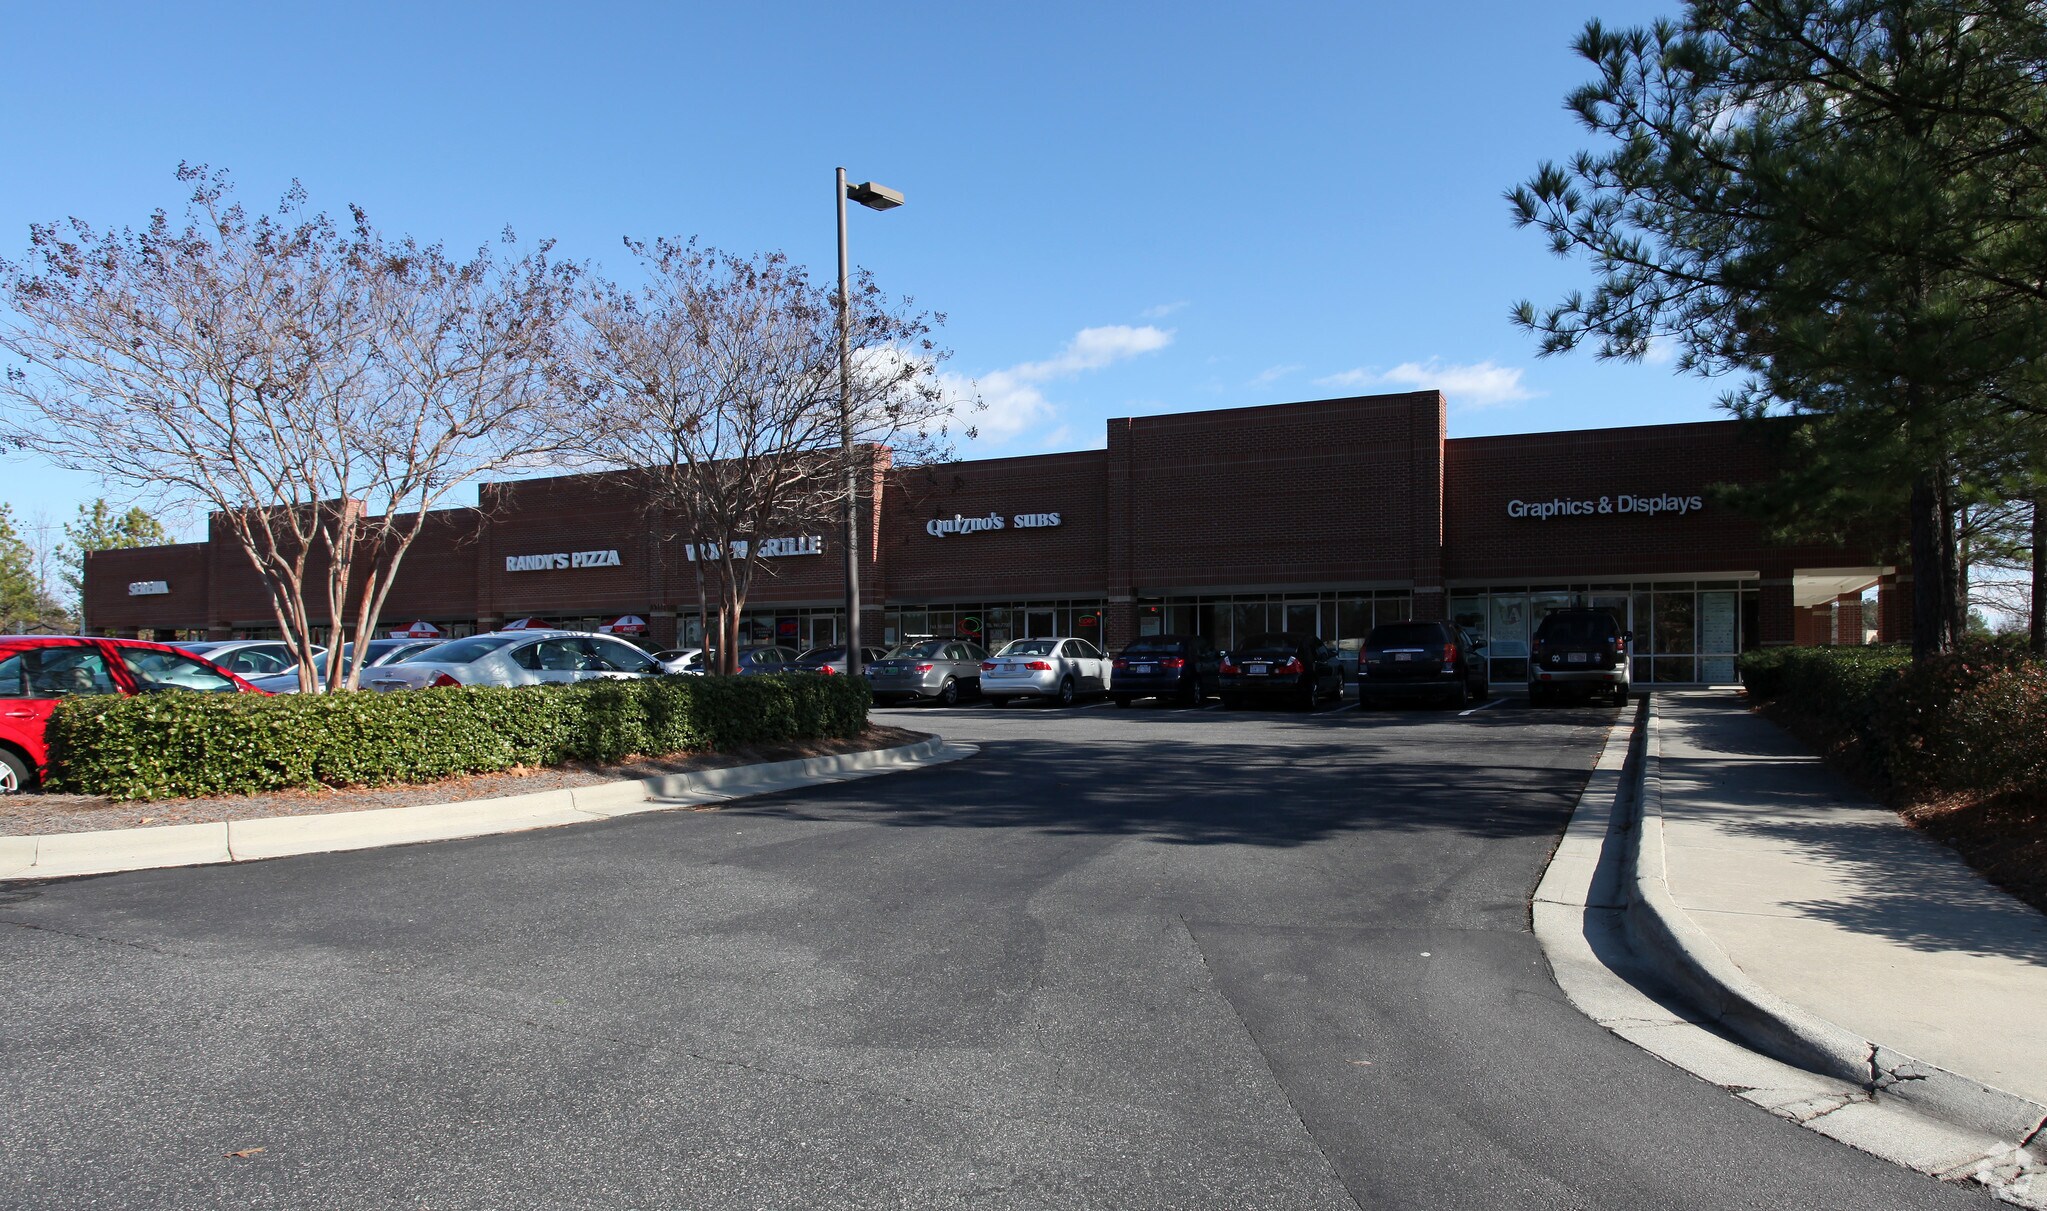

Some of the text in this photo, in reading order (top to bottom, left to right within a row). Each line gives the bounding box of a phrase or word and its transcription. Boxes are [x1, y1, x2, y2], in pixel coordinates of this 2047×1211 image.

[1507, 493, 1703, 520] Graphics & Displays
[756, 535, 822, 558] GRILLE
[506, 549, 621, 572] RANDY'S PIZZA
